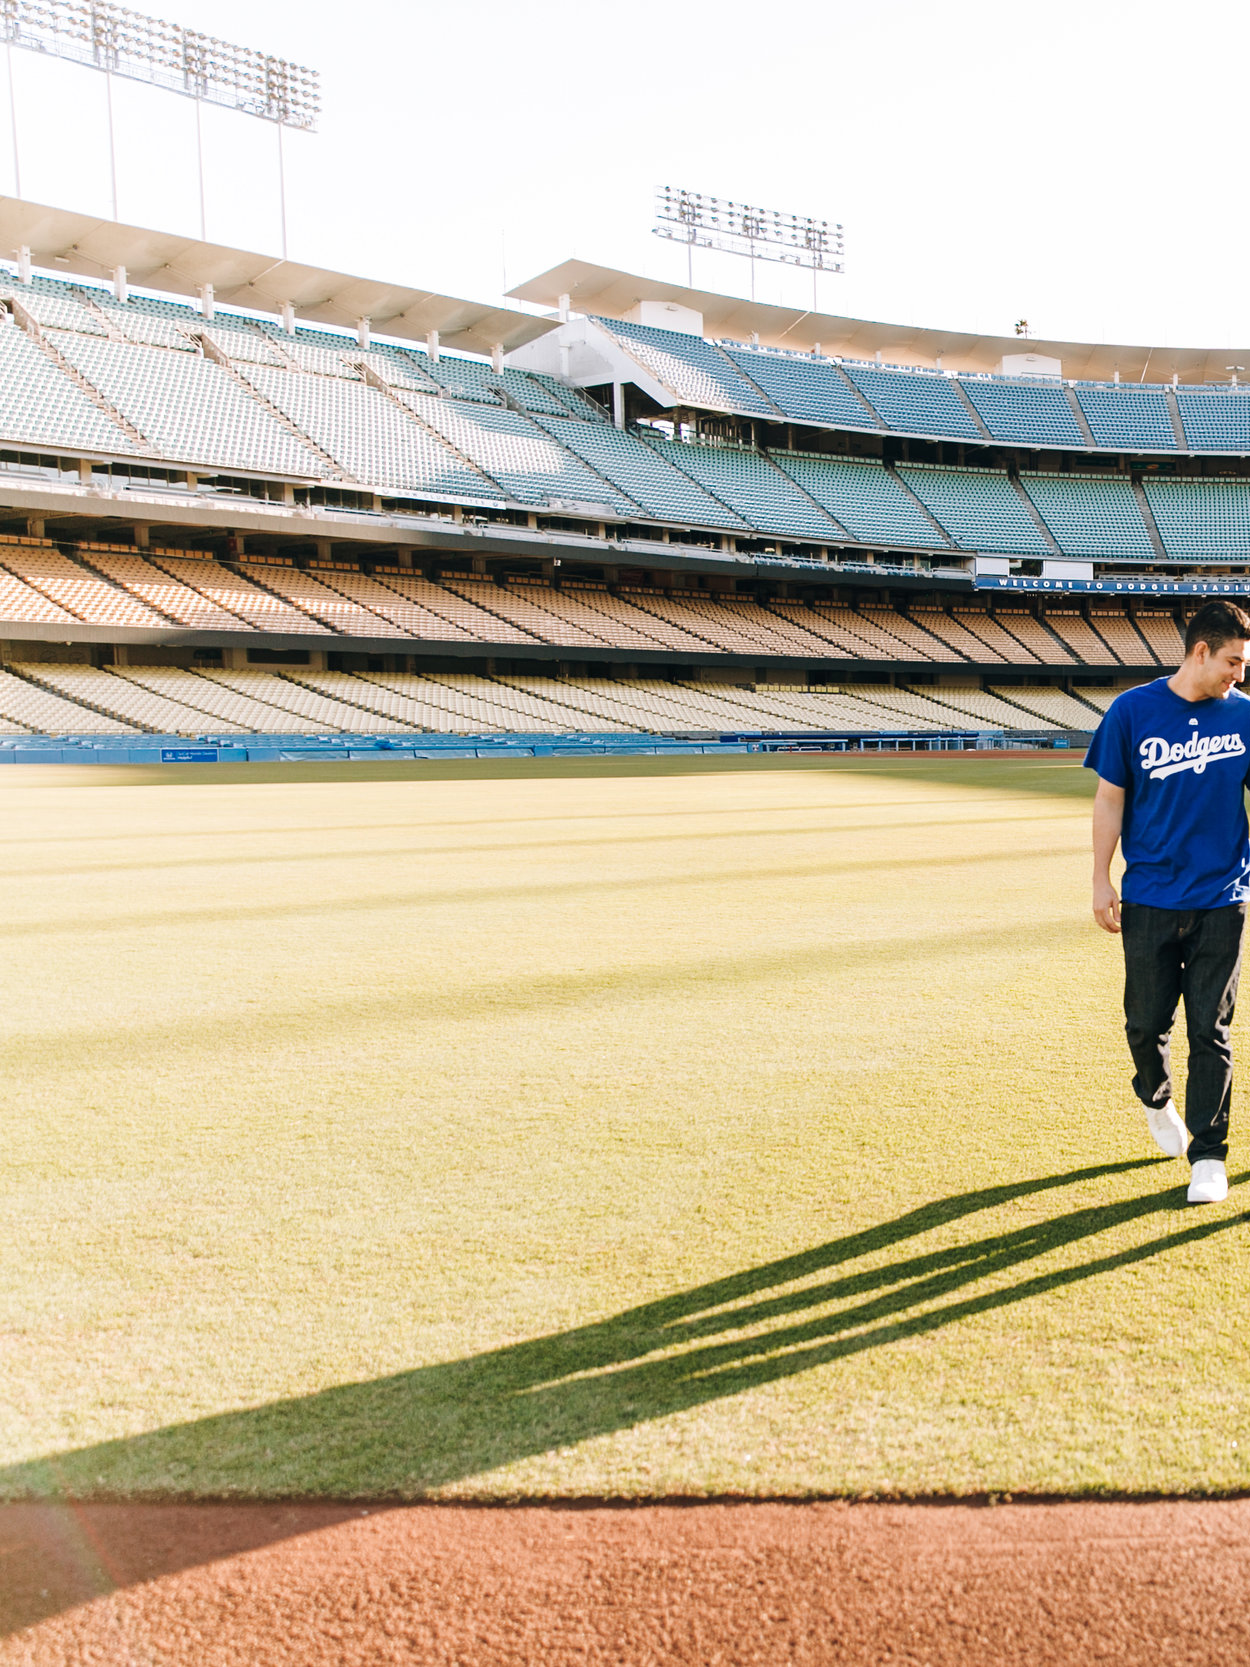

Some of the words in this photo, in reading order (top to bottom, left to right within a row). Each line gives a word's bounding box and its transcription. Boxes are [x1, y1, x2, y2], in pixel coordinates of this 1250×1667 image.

[424, 493, 447, 501] CLUB
[453, 497, 484, 506] SUITES
[999, 578, 1073, 588] WELCOME
[1086, 582, 1103, 590] TO
[1116, 582, 1179, 591] DODGER
[1139, 731, 1246, 780] Dodgers
